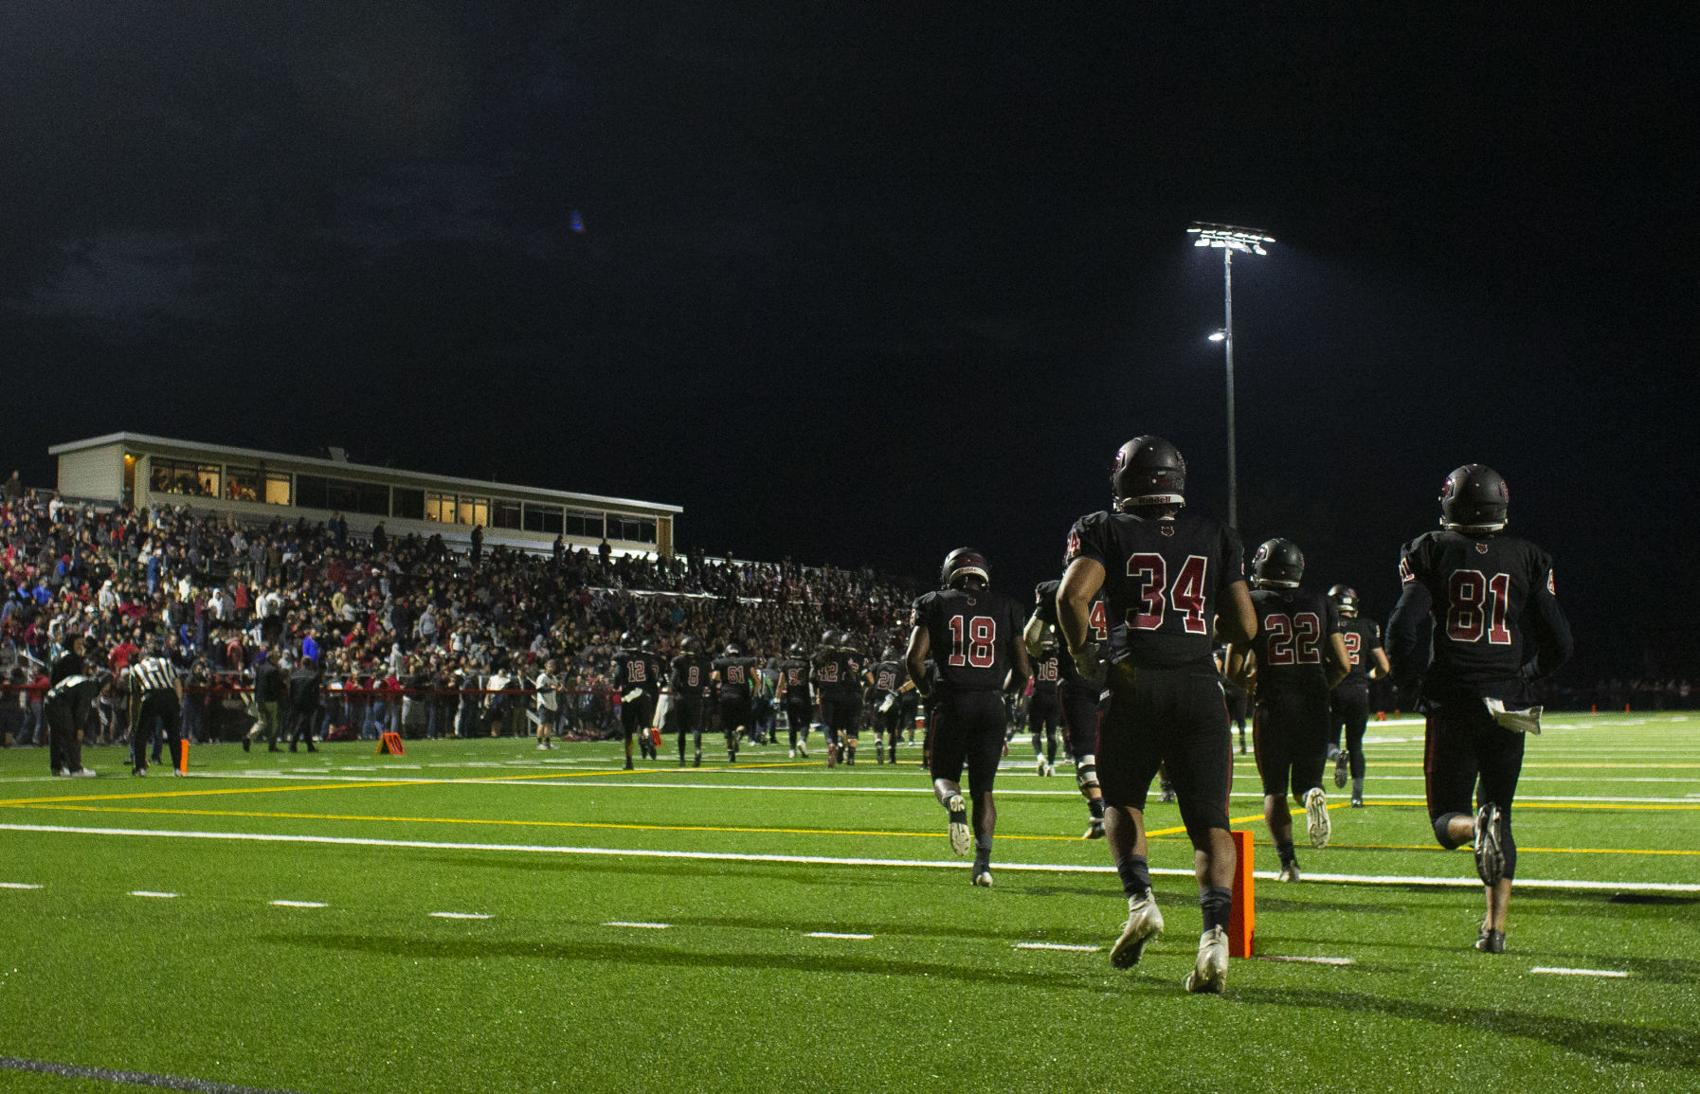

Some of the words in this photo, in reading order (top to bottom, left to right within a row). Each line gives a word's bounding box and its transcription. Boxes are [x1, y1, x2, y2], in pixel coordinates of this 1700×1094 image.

[1125, 553, 1208, 635] 34
[1446, 569, 1511, 645] 81
[948, 615, 996, 668] 18
[1264, 612, 1320, 665] 22
[626, 660, 647, 682] 12
[877, 671, 896, 690] 21
